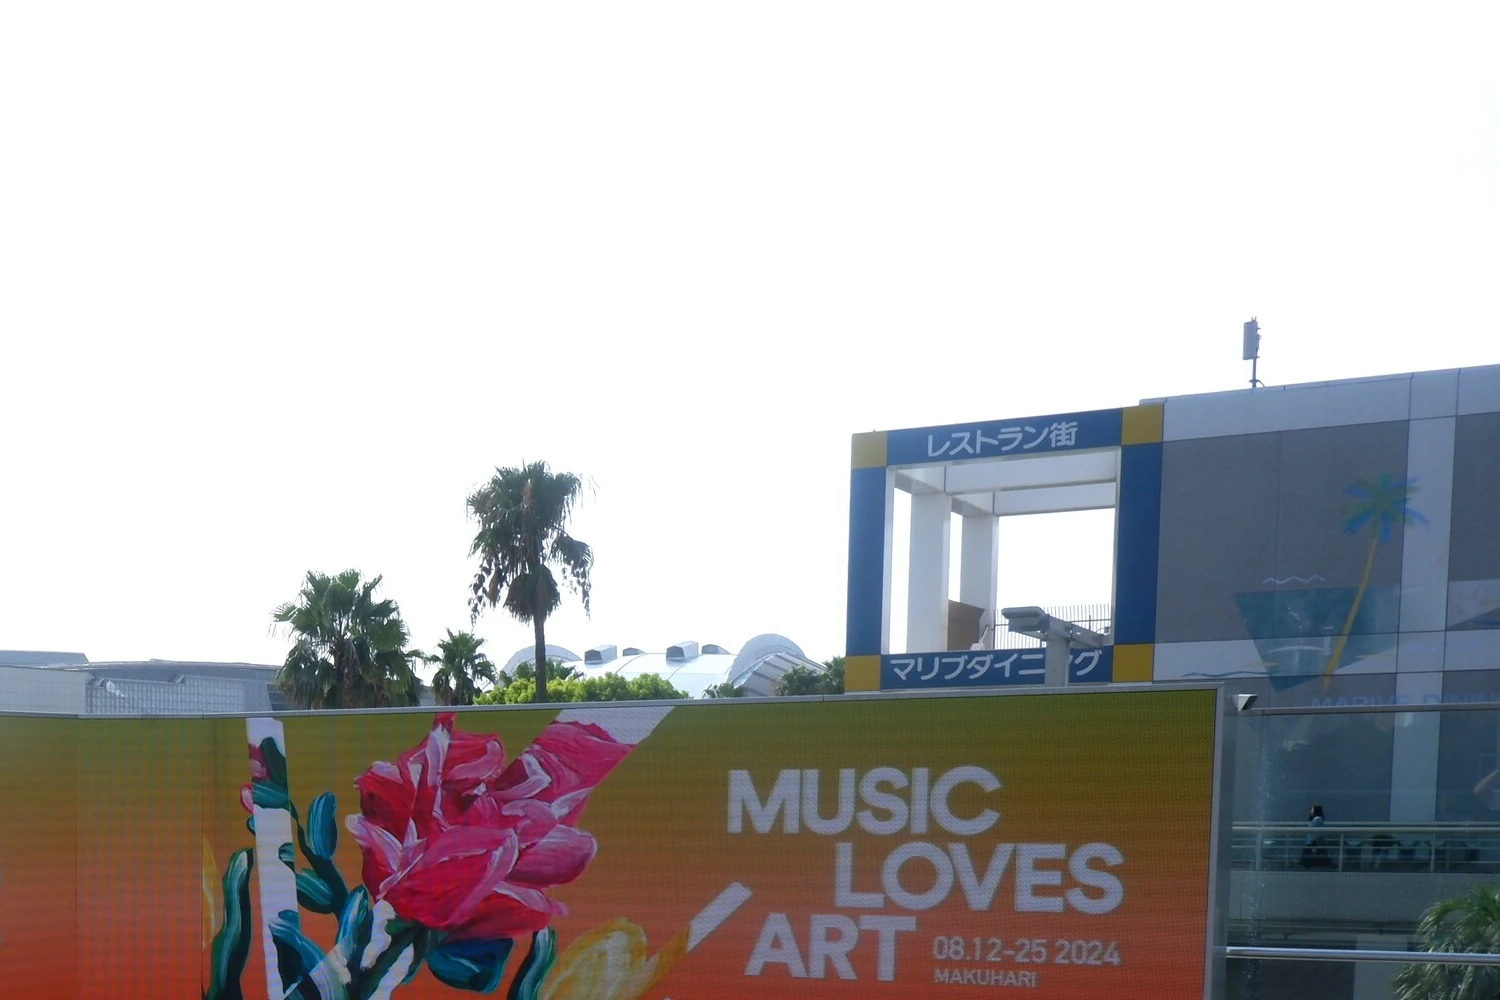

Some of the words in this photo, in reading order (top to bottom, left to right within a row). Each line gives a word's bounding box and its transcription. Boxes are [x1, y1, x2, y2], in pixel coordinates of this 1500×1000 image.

[927, 421, 1078, 457] レストラン街
[890, 649, 1103, 681] マリブダイニグ
[727, 764, 1002, 836] MUSIC
[834, 841, 1125, 915] LOVES
[744, 912, 916, 982] ART
[933, 935, 1048, 964] 08.12-25
[1054, 938, 1122, 966] 2024
[934, 967, 1039, 988] MAKUHARI
